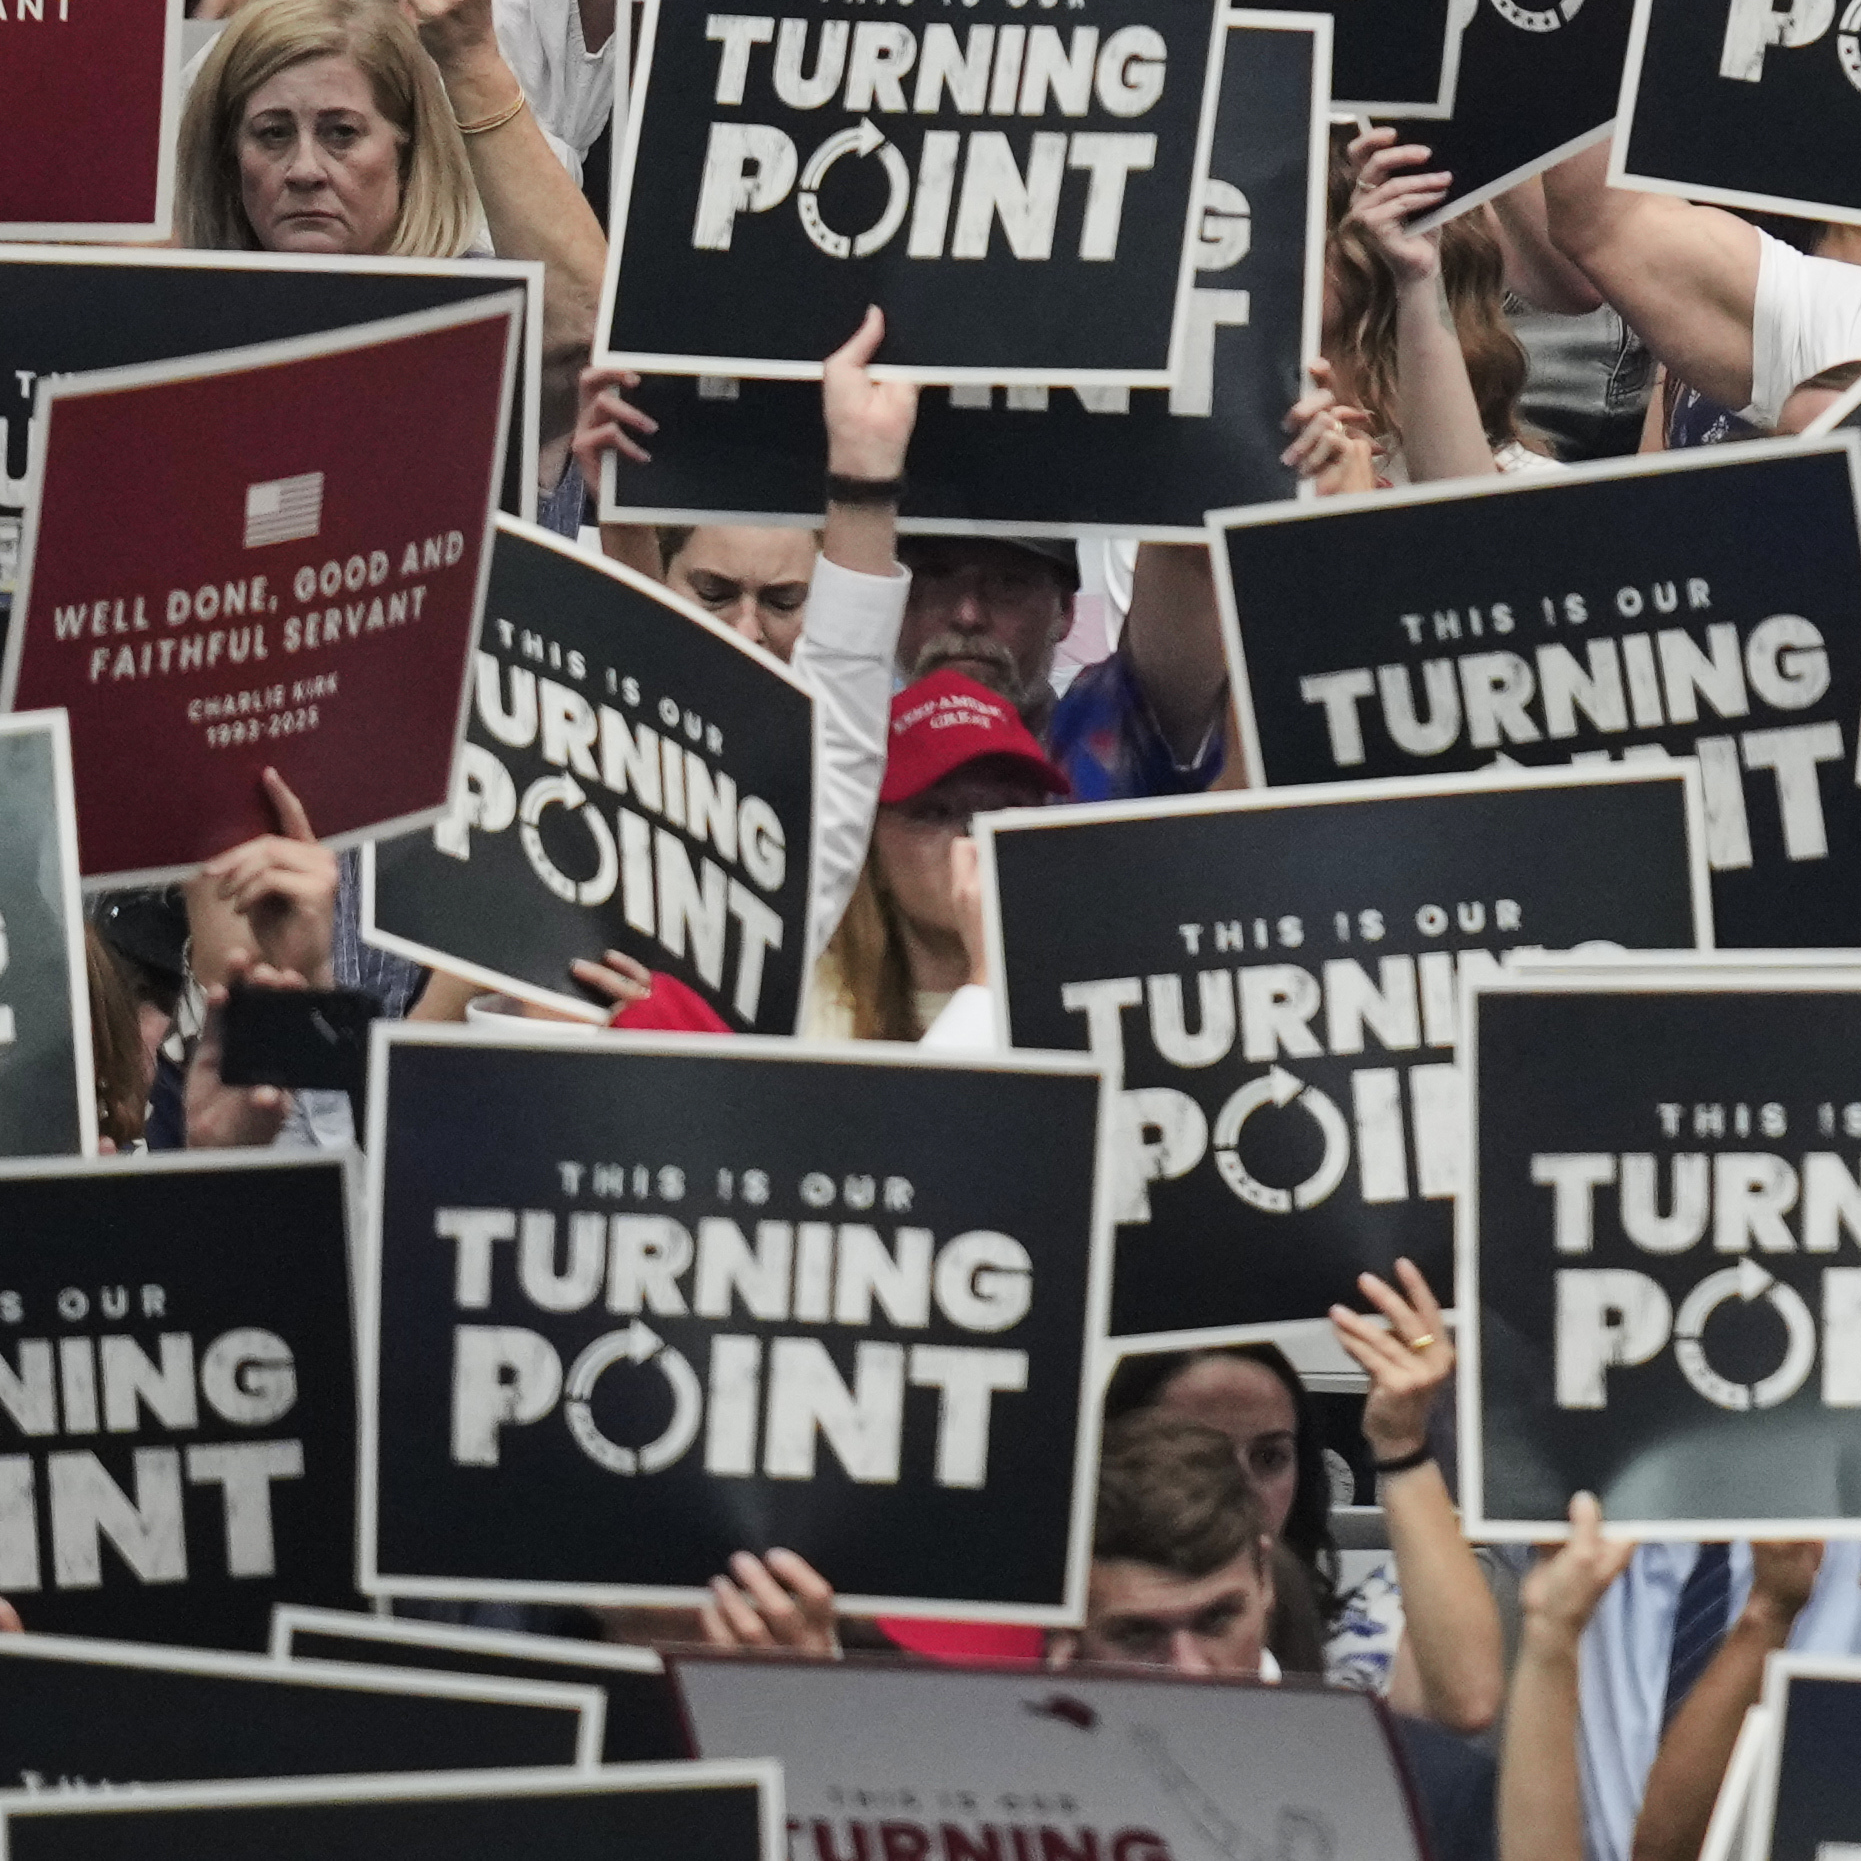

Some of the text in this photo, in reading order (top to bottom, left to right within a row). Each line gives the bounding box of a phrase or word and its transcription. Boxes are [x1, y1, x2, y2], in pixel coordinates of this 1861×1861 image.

[706, 14, 1167, 116] TURNING
[693, 118, 1157, 261] POINT
[55, 531, 463, 640] WELL DONE, GOOD AND
[90, 586, 426, 682] FAITHFUL SERVANT
[1401, 578, 1710, 644] THIS IS OUR
[1301, 604, 1839, 773] TURNING
[1659, 1103, 1787, 1137] THIS
[559, 1162, 914, 1210] THIS IS OUR
[436, 1210, 1031, 1331] TURNING
[453, 1320, 1028, 1488] POINT
